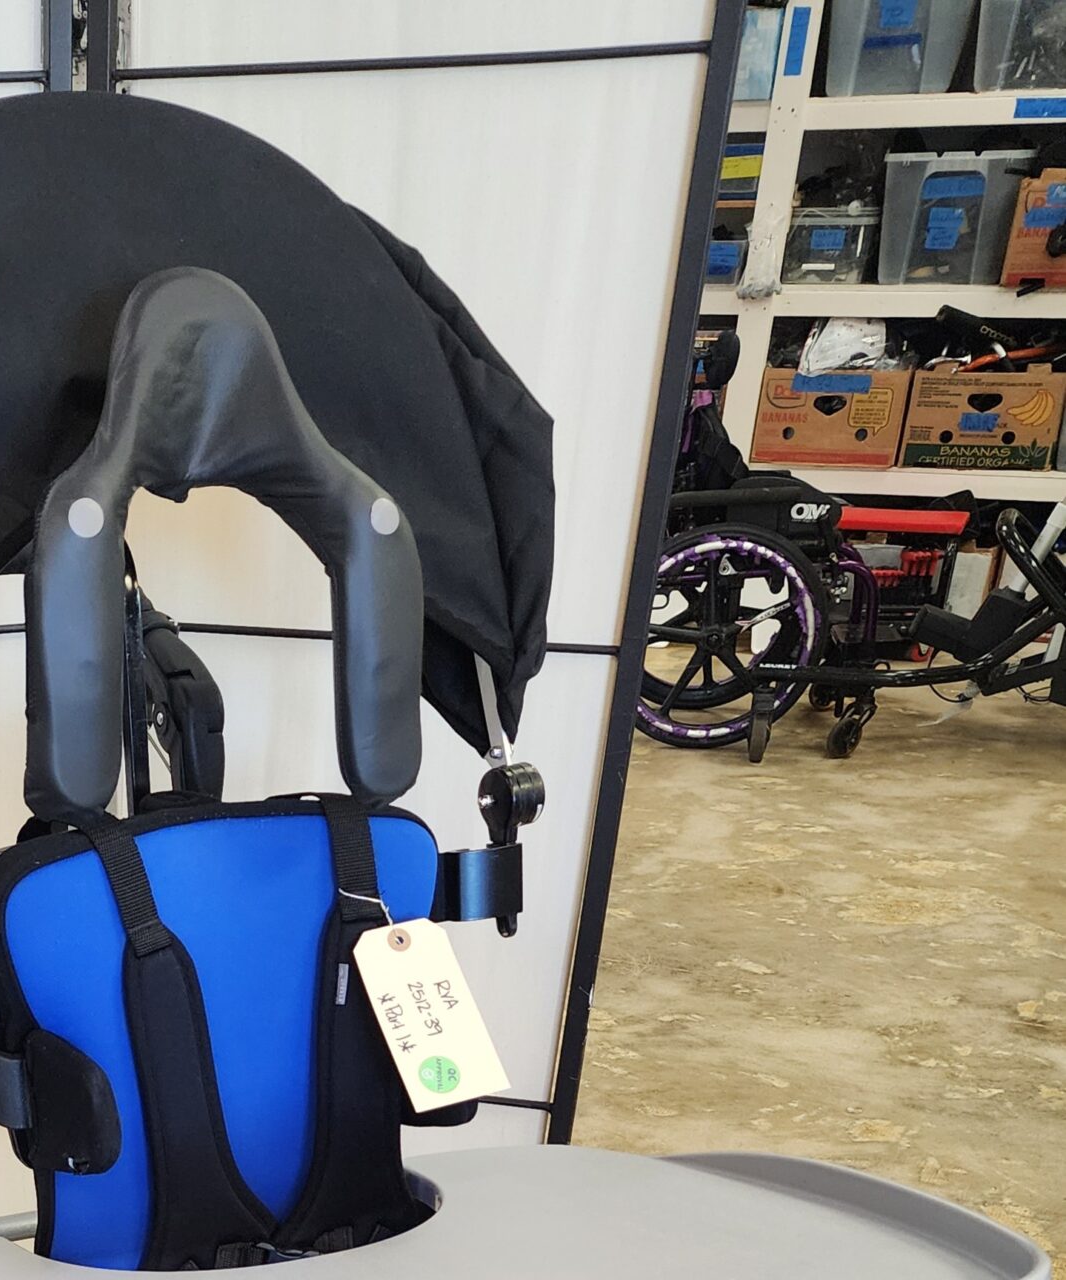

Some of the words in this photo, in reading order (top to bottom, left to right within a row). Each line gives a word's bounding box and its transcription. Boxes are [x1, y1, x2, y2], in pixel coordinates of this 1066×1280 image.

[918, 456, 974, 467] CERTIFIED
[940, 446, 1011, 457] BANANAS
[433, 980, 459, 1010] RVA
[407, 982, 443, 1036] 2512-39
